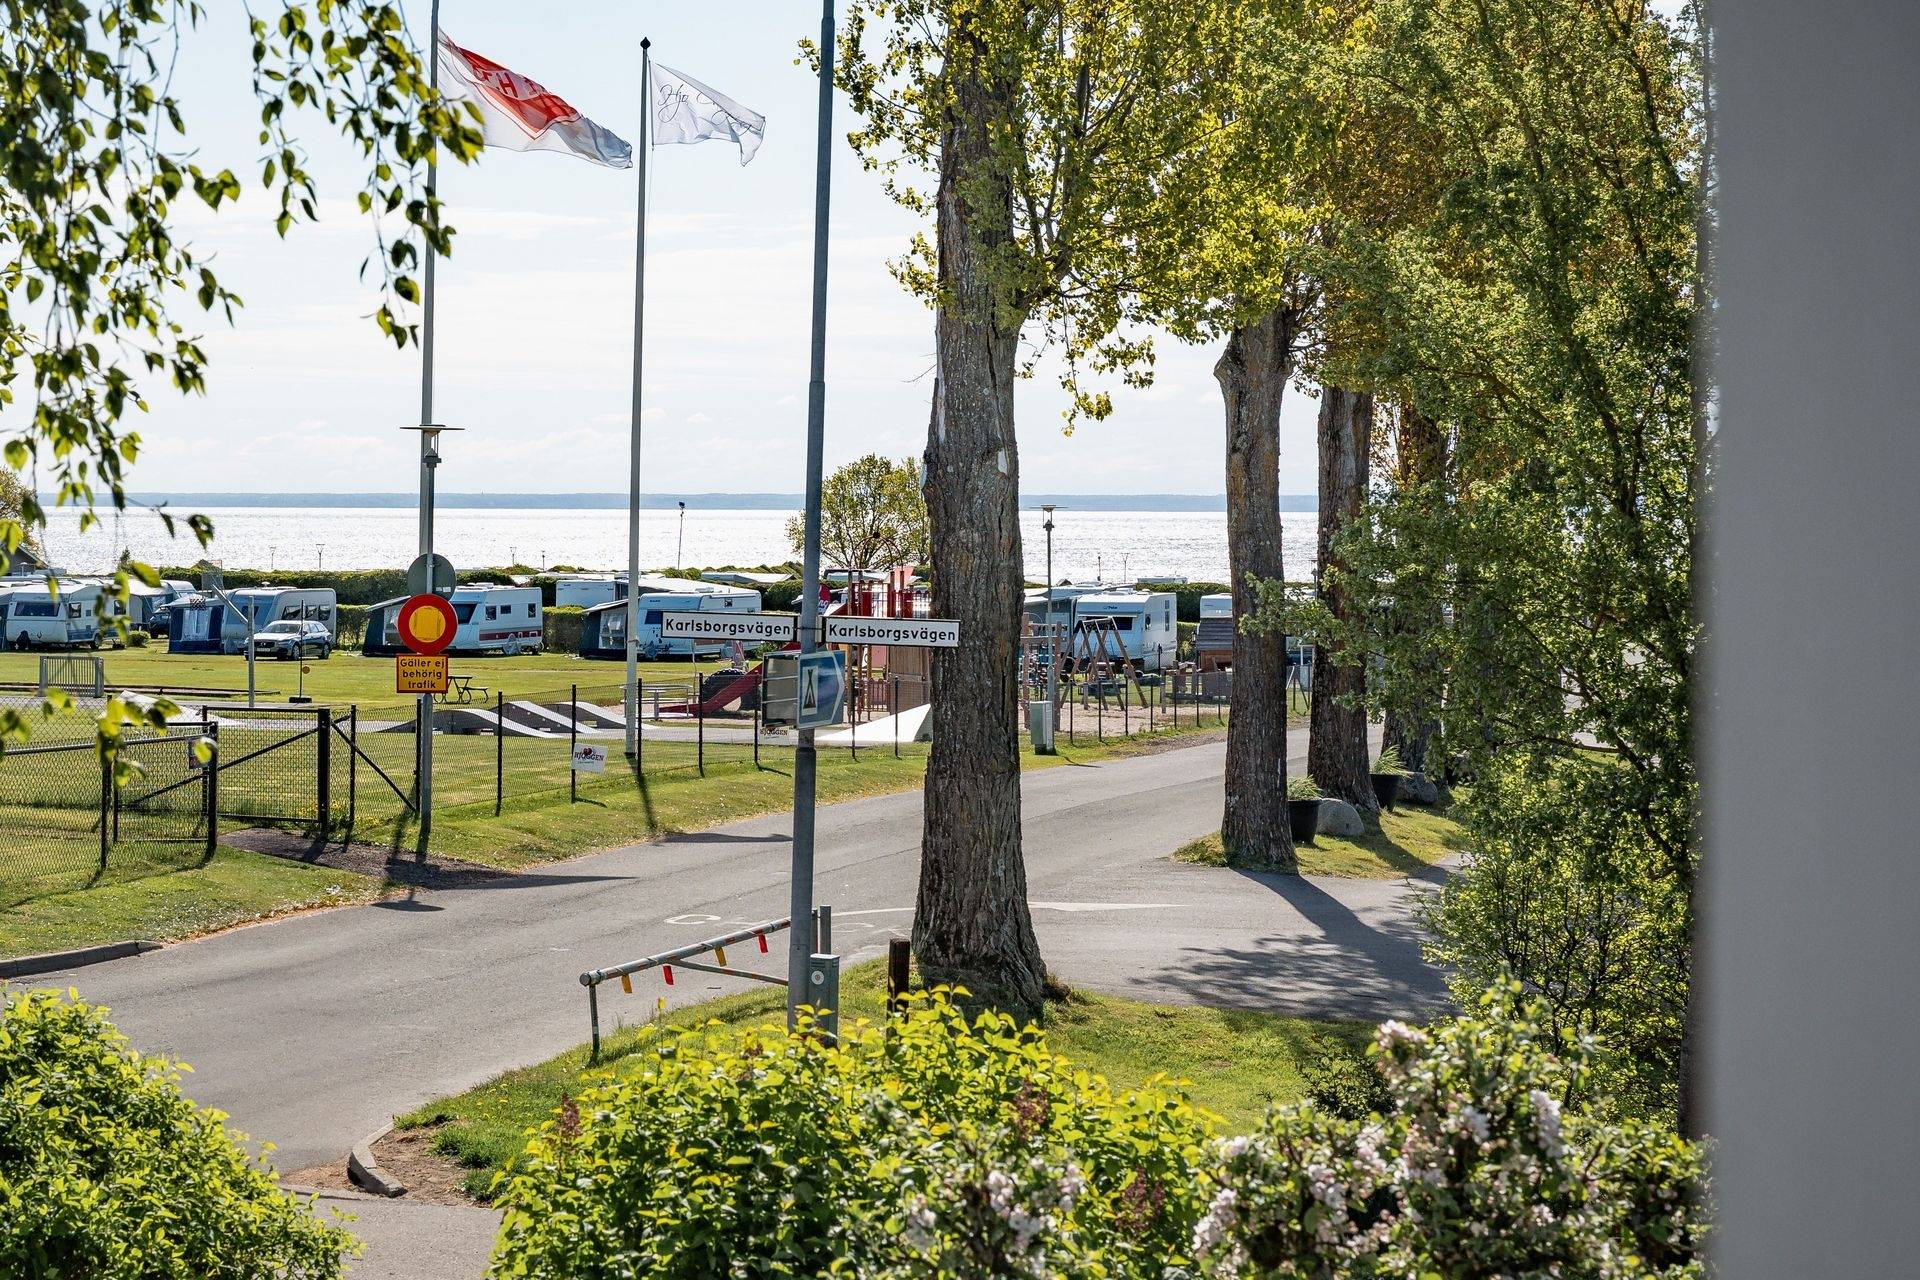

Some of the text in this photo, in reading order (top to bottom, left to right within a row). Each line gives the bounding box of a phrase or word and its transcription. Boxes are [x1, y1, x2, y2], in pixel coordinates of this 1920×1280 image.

[665, 618, 791, 637] Karlsborgsvägen
[829, 624, 956, 643] Karlsborgsvägen
[400, 658, 445, 669] Gäller ej
[402, 669, 442, 680] behörig
[408, 680, 436, 689] trafik
